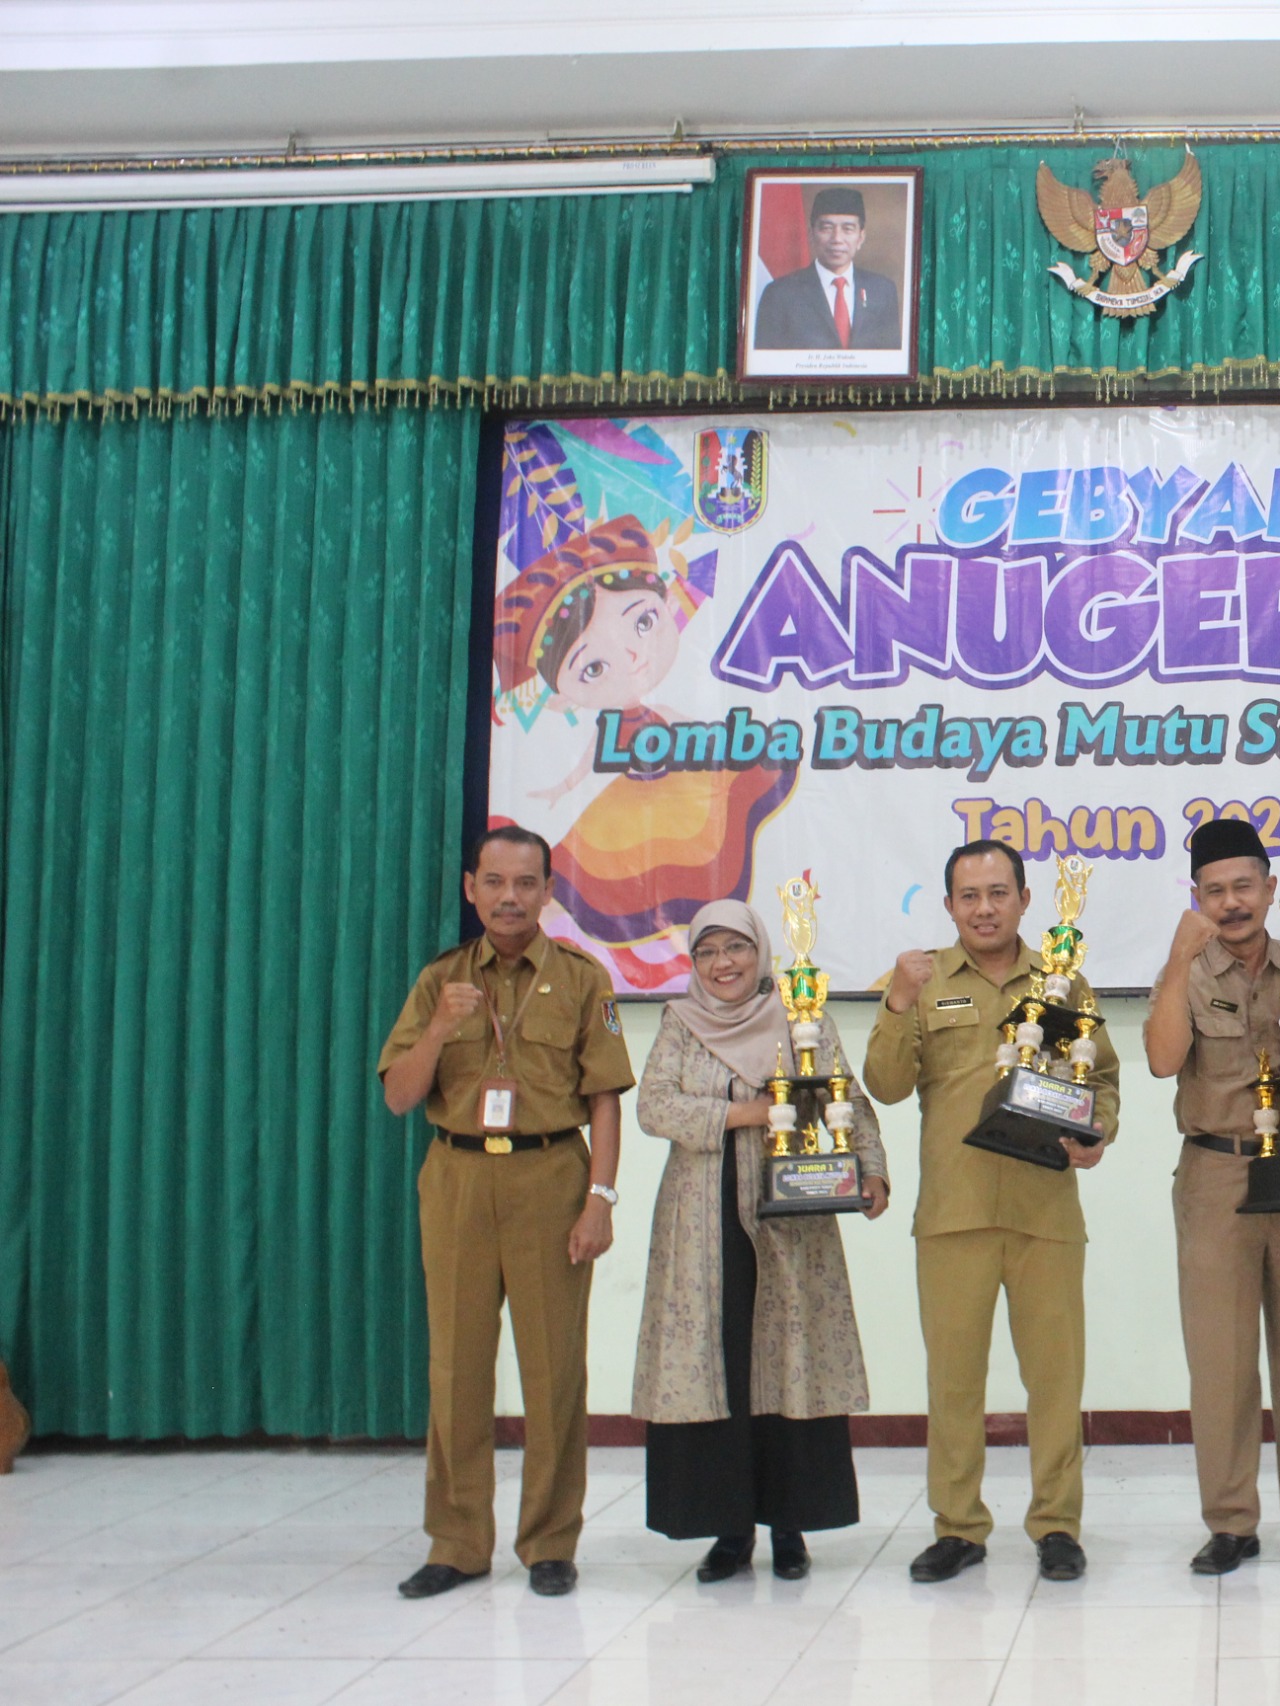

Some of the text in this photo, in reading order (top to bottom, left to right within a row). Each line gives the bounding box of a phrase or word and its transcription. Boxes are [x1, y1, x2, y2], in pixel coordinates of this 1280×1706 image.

[594, 707, 803, 772] Lomba
[812, 704, 1047, 782] Budaya
[1056, 701, 1229, 766] Mutu
[952, 796, 1166, 862] Tahun
[1039, 1080, 1066, 1093] JUARA
[797, 1163, 834, 1174] JUARA 1
